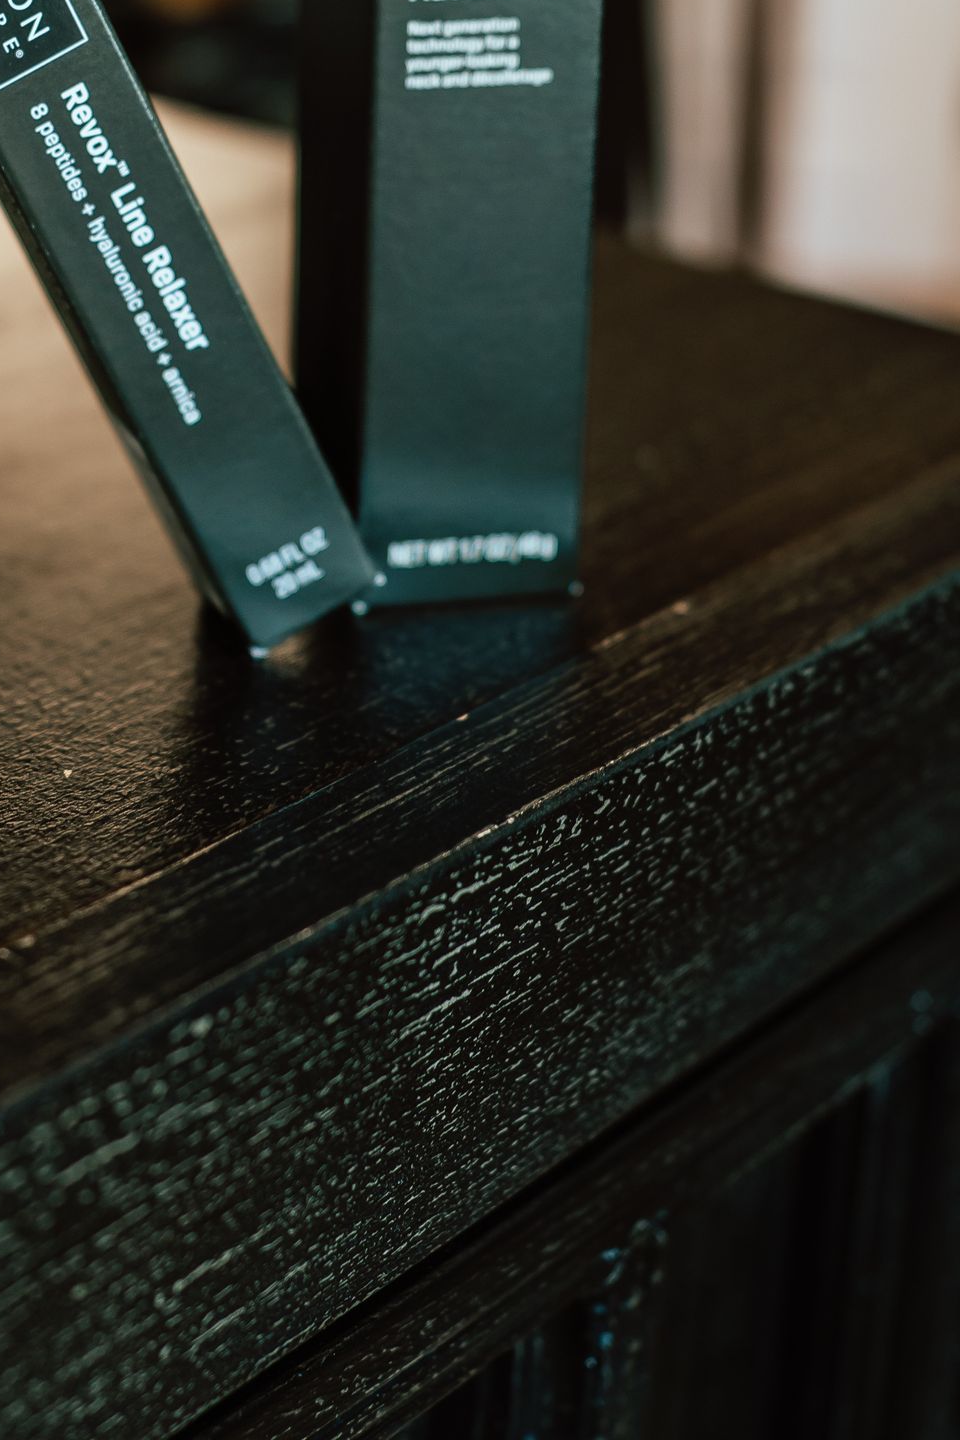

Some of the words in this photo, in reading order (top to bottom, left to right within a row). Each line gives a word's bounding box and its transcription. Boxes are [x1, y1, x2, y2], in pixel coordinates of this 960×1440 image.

[30, 102, 50, 121] 8
[34, 120, 88, 203] peptides
[81, 202, 97, 217] +
[86, 215, 144, 313] hyaluronic
[110, 181, 155, 248] Line
[142, 245, 210, 351] Relaxer
[133, 310, 169, 353] acid
[156, 352, 172, 367] +
[161, 366, 202, 427] arnica
